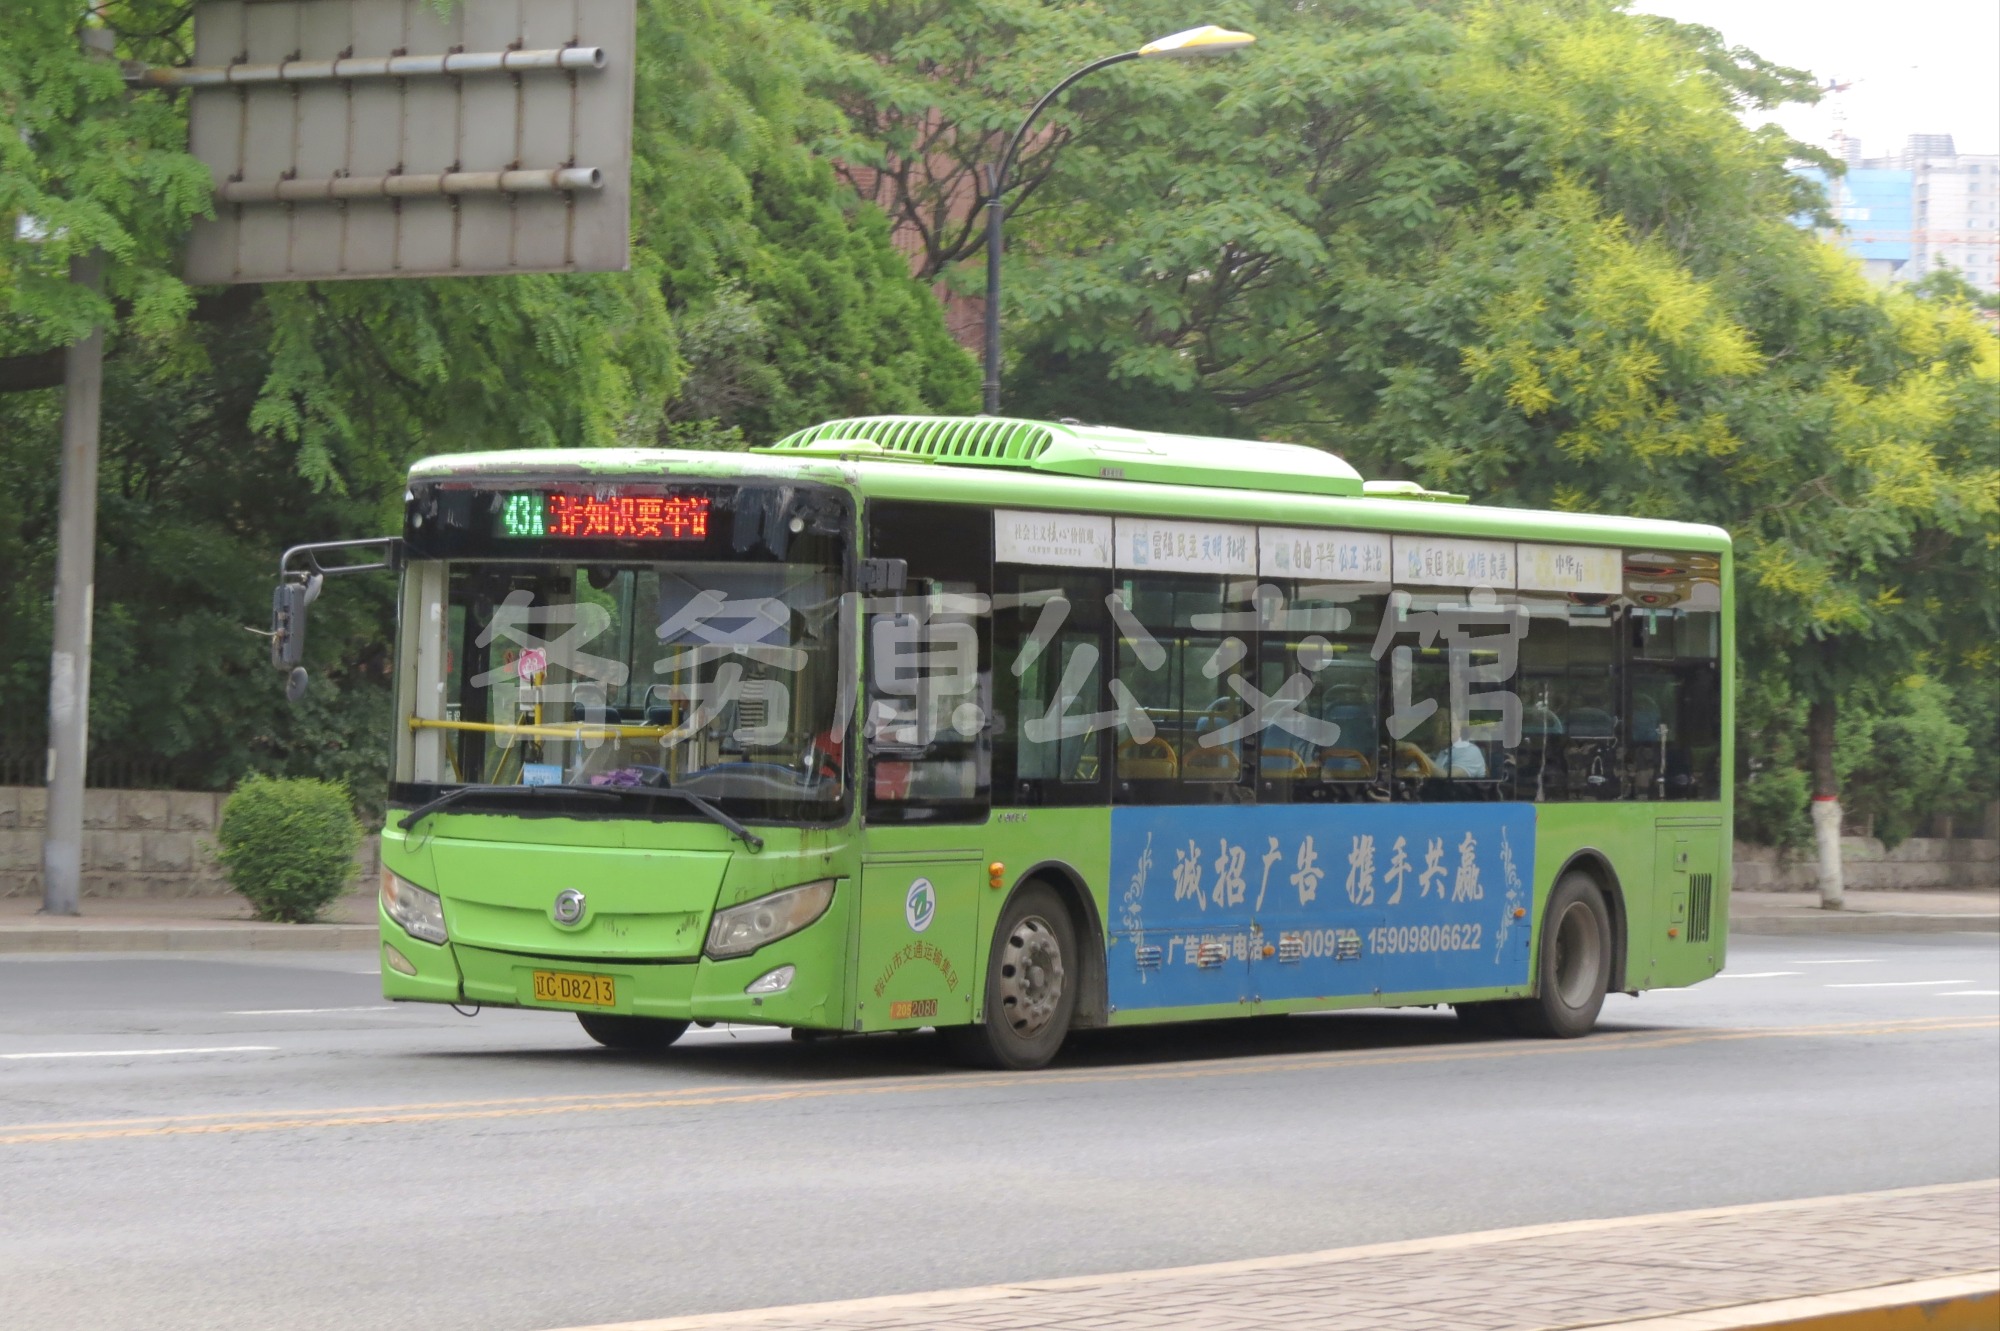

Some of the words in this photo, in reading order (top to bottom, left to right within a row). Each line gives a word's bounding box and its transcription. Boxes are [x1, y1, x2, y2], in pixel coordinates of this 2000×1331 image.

[550, 496, 709, 536] 诈知识要牢记
[1014, 521, 1095, 545] 社会主义核心价值观
[1172, 835, 1325, 912] 诚招广告
[1346, 831, 1484, 906] 携手共赢
[1368, 923, 1482, 954] 15909806622
[873, 940, 959, 998] 鞍山市交通运输集团
